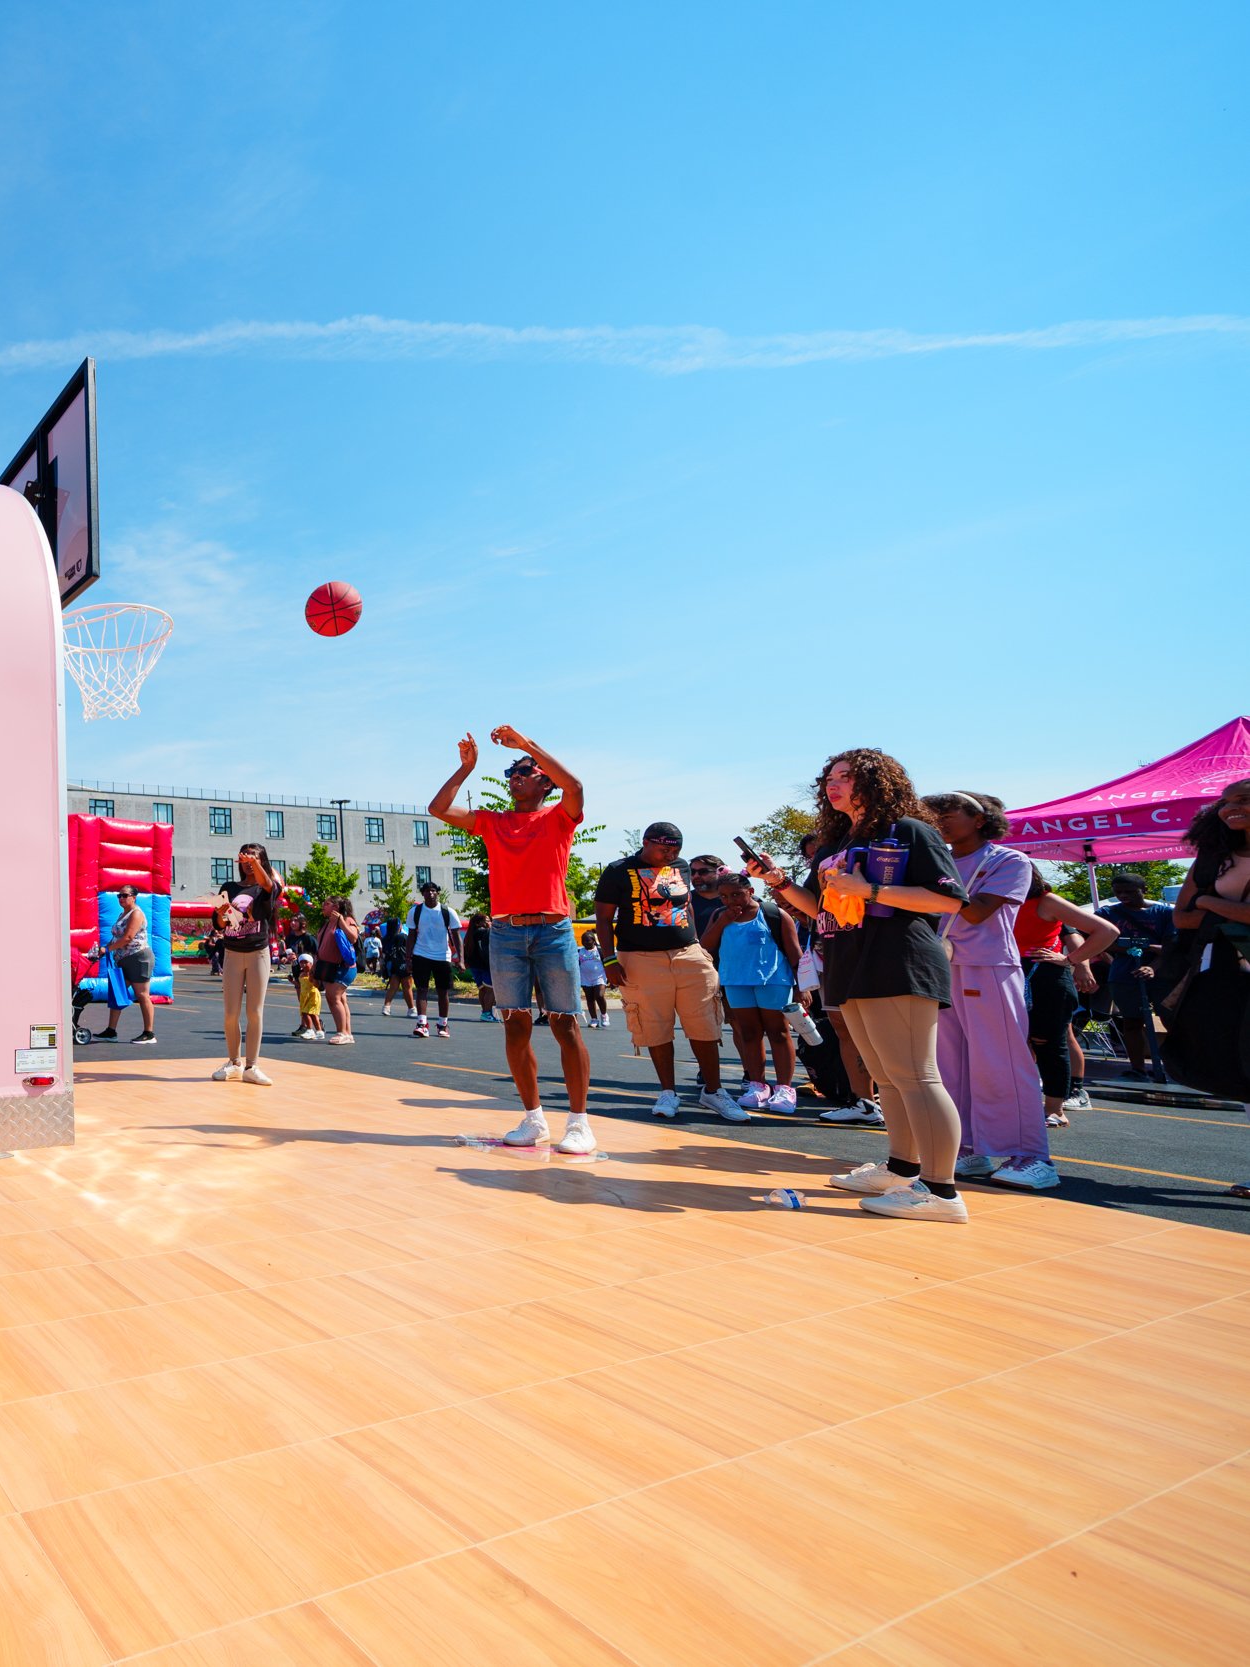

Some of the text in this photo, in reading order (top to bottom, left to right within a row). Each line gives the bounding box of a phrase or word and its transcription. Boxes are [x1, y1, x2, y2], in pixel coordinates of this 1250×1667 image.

[1088, 789, 1183, 802] ANGEL
[1021, 808, 1182, 837] ANGEL C.
